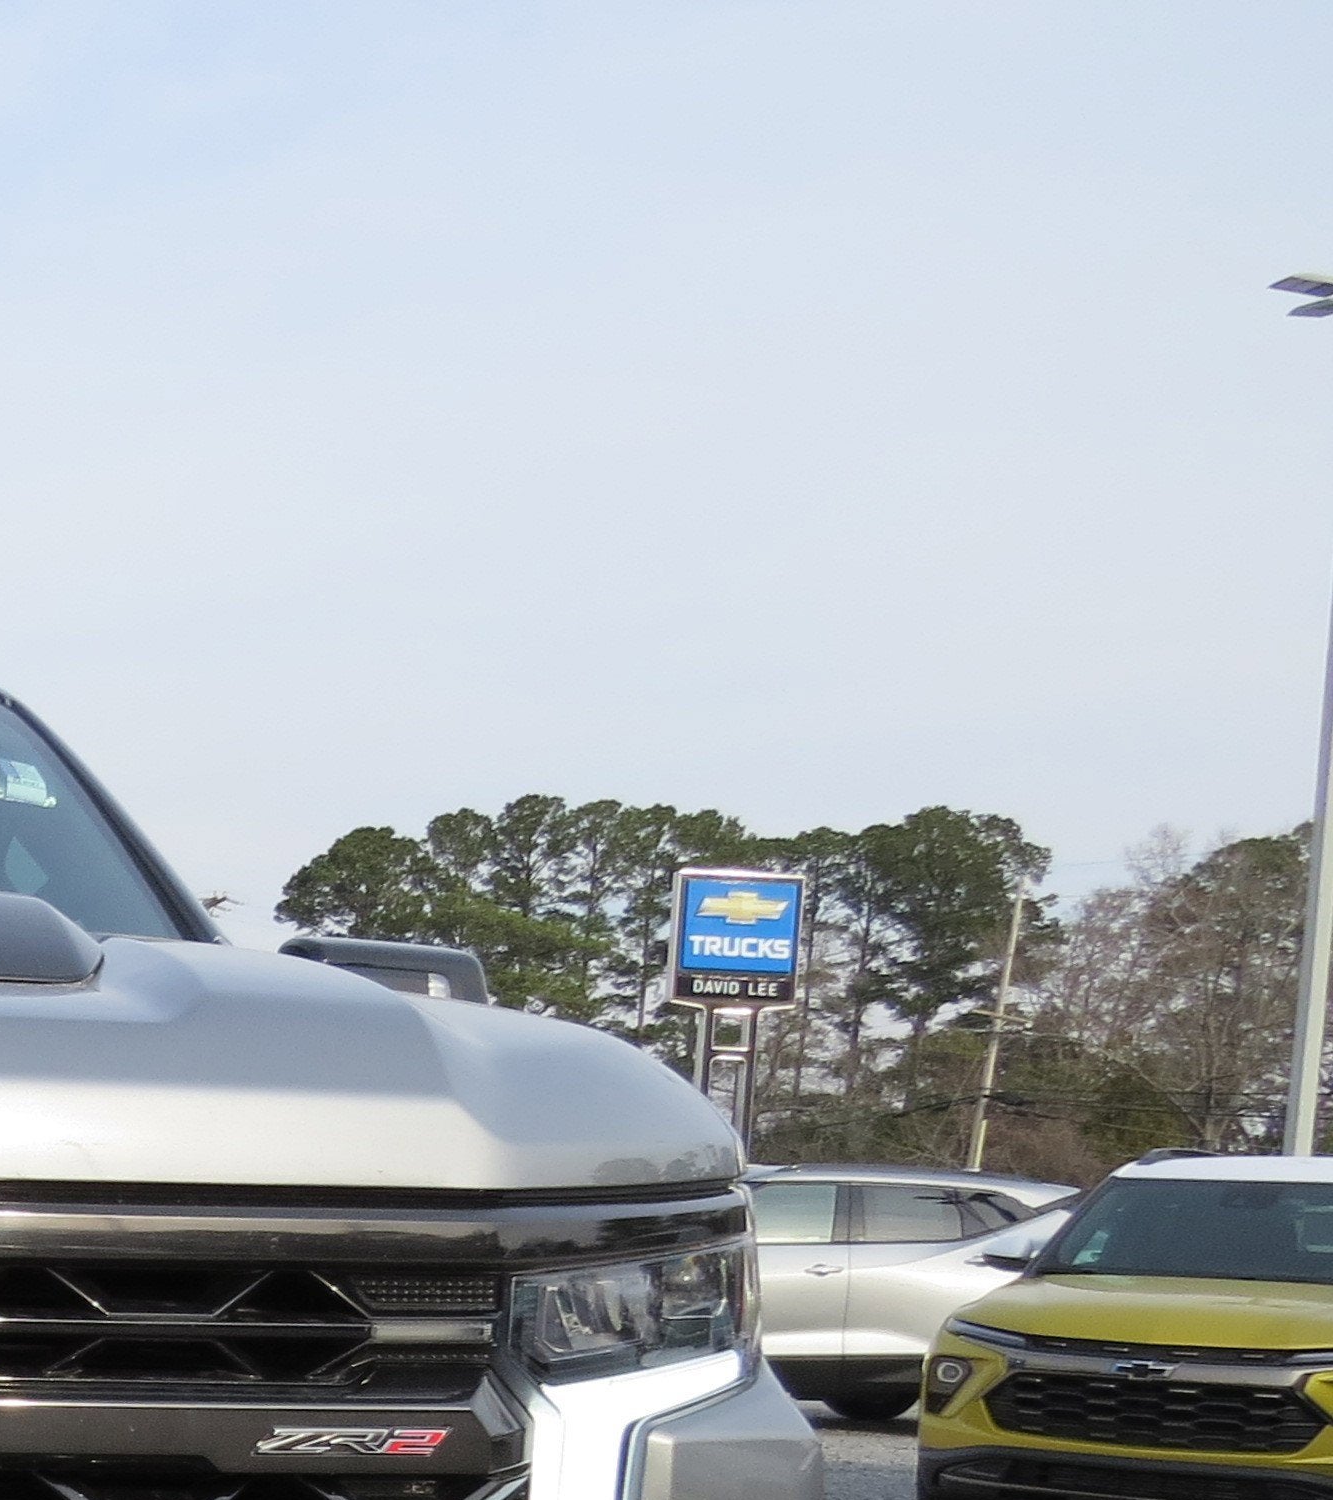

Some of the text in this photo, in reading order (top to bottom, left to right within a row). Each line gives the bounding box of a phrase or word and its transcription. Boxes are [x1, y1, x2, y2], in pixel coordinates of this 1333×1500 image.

[689, 935, 791, 960] TRUCKS
[692, 979, 779, 997] DAVID LEE
[251, 1426, 453, 1457] ZR2
